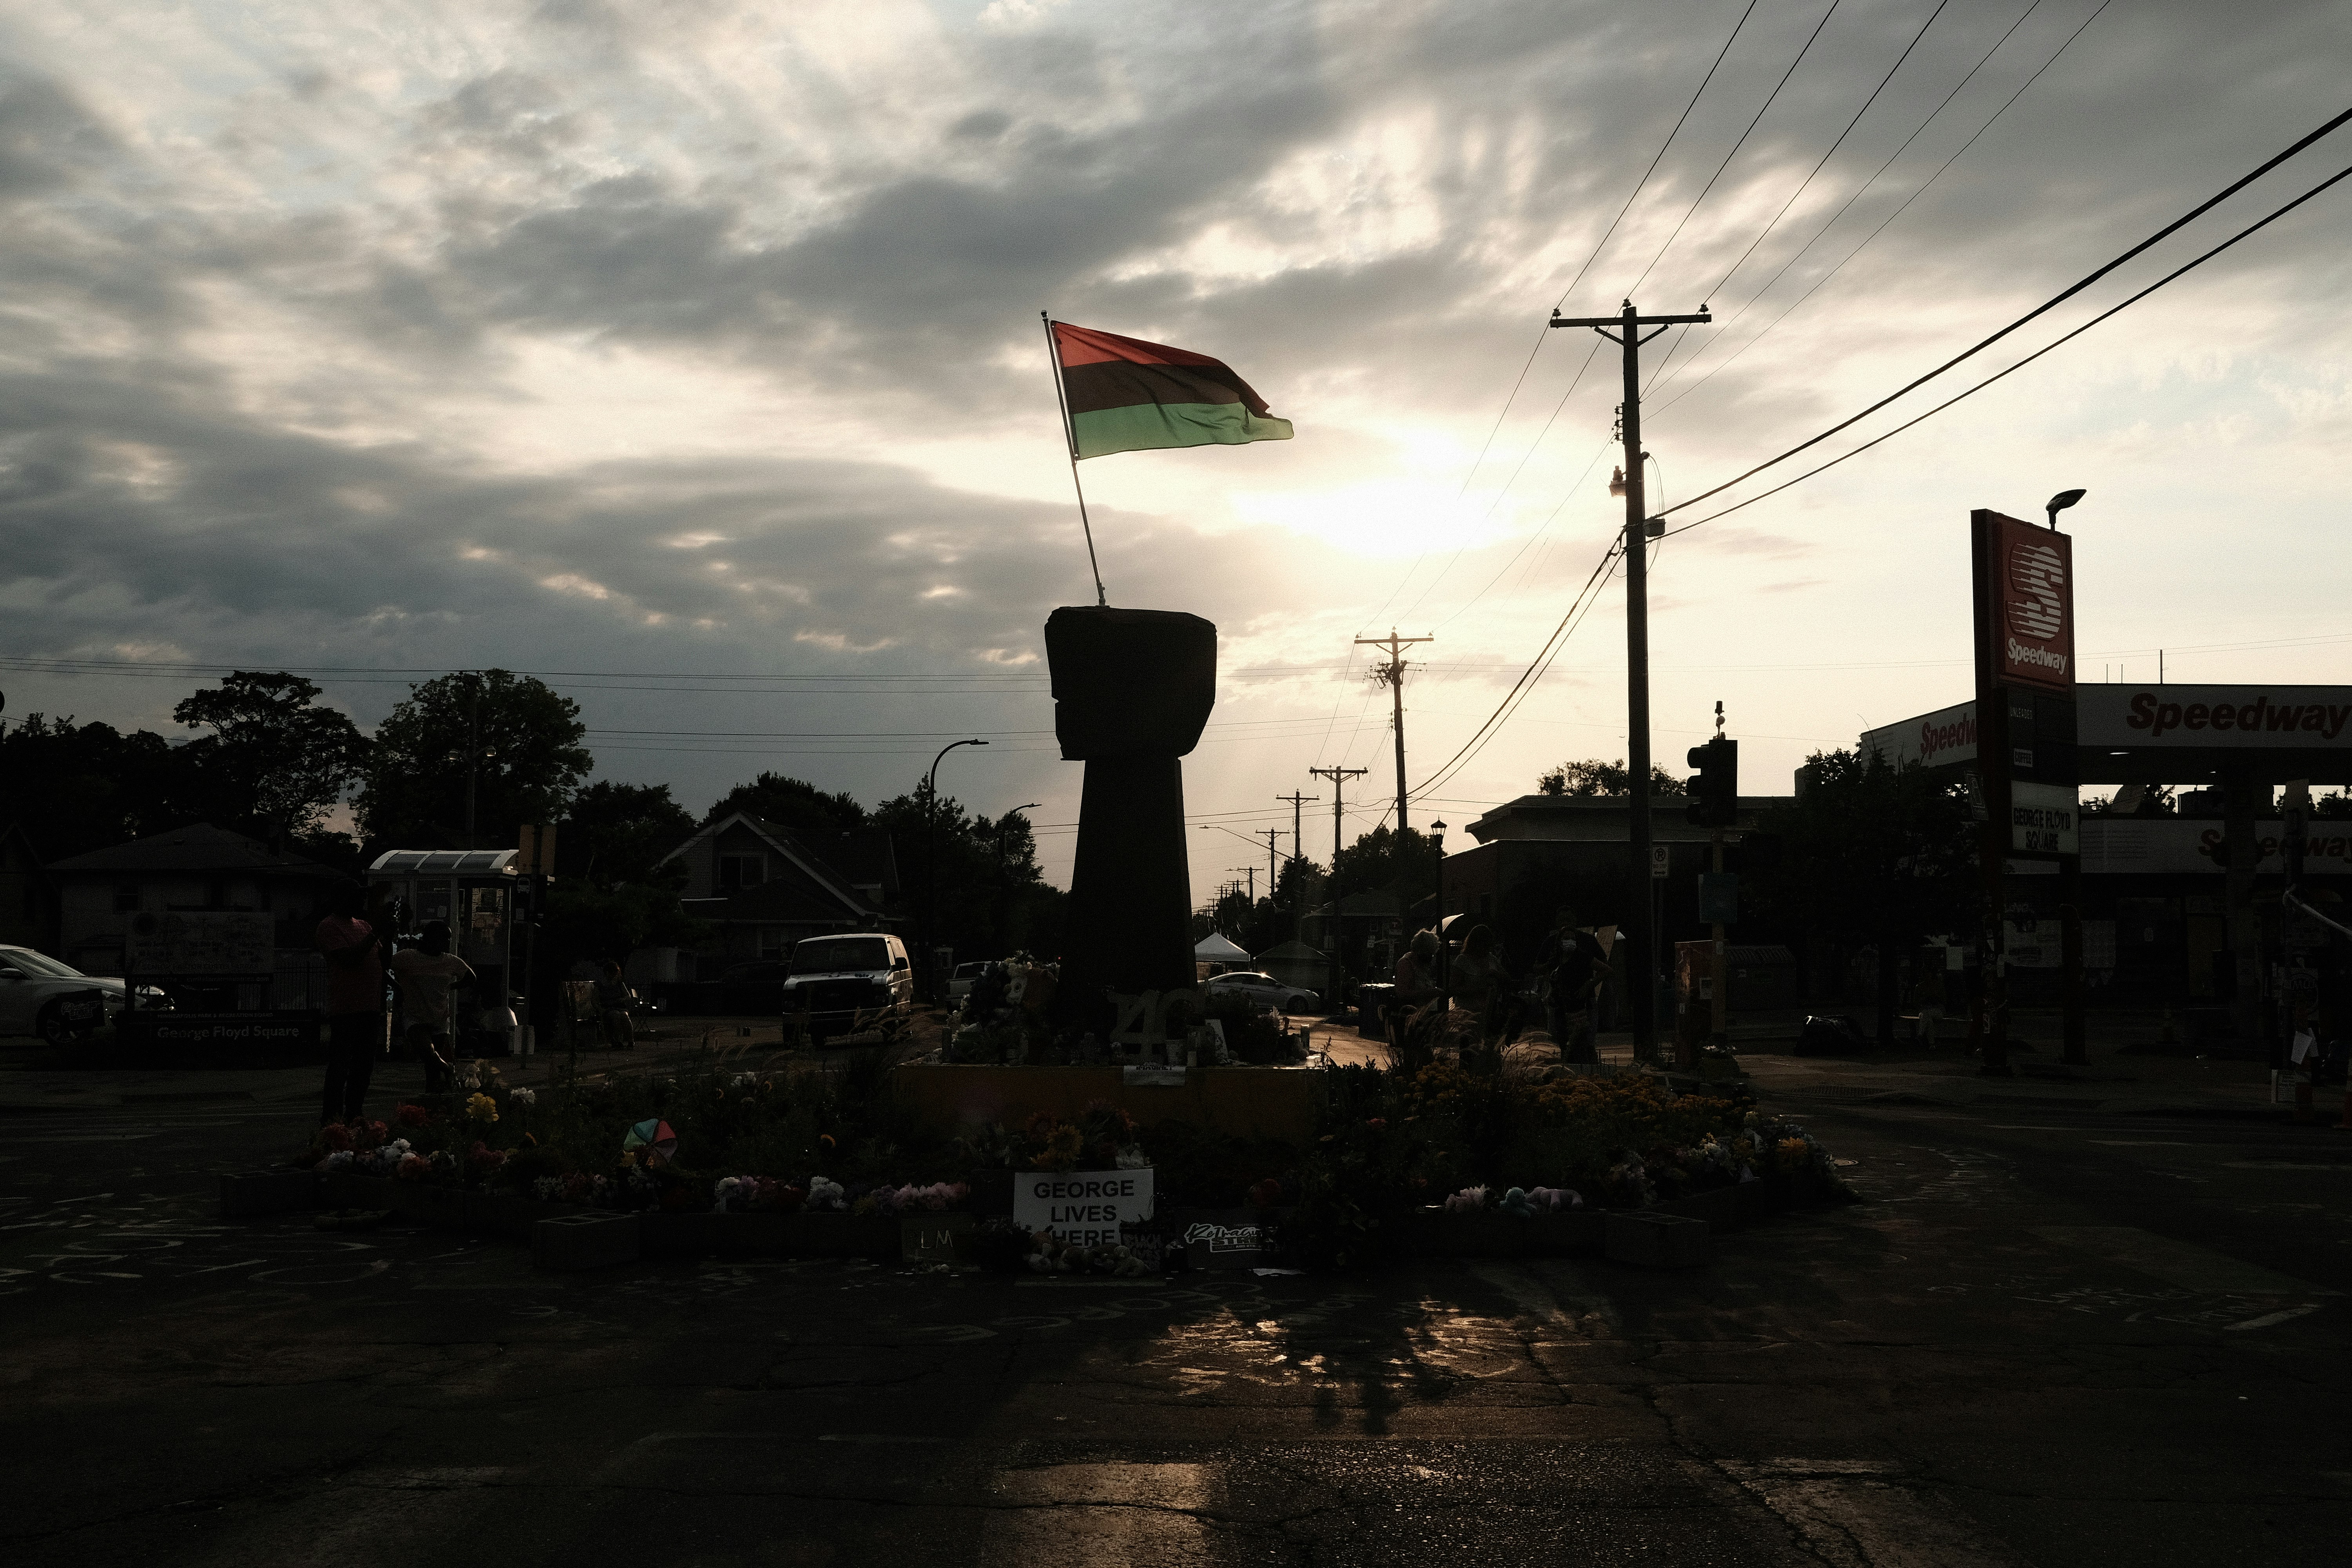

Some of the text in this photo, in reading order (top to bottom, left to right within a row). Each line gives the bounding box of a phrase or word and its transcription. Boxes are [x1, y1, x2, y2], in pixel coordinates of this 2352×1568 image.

[2007, 637, 2067, 675] Speedway
[2126, 692, 2352, 739] Speedway
[1920, 719, 1977, 759] Speedw
[2013, 808, 2070, 829] GEORGE FLOYD
[2026, 831, 2058, 851] SQUARE
[157, 1025, 300, 1041] George Floyd Square
[1034, 1180, 1134, 1198] GEORGE
[1051, 1205, 1117, 1222] LIVES
[1052, 1229, 1114, 1247] HERE
